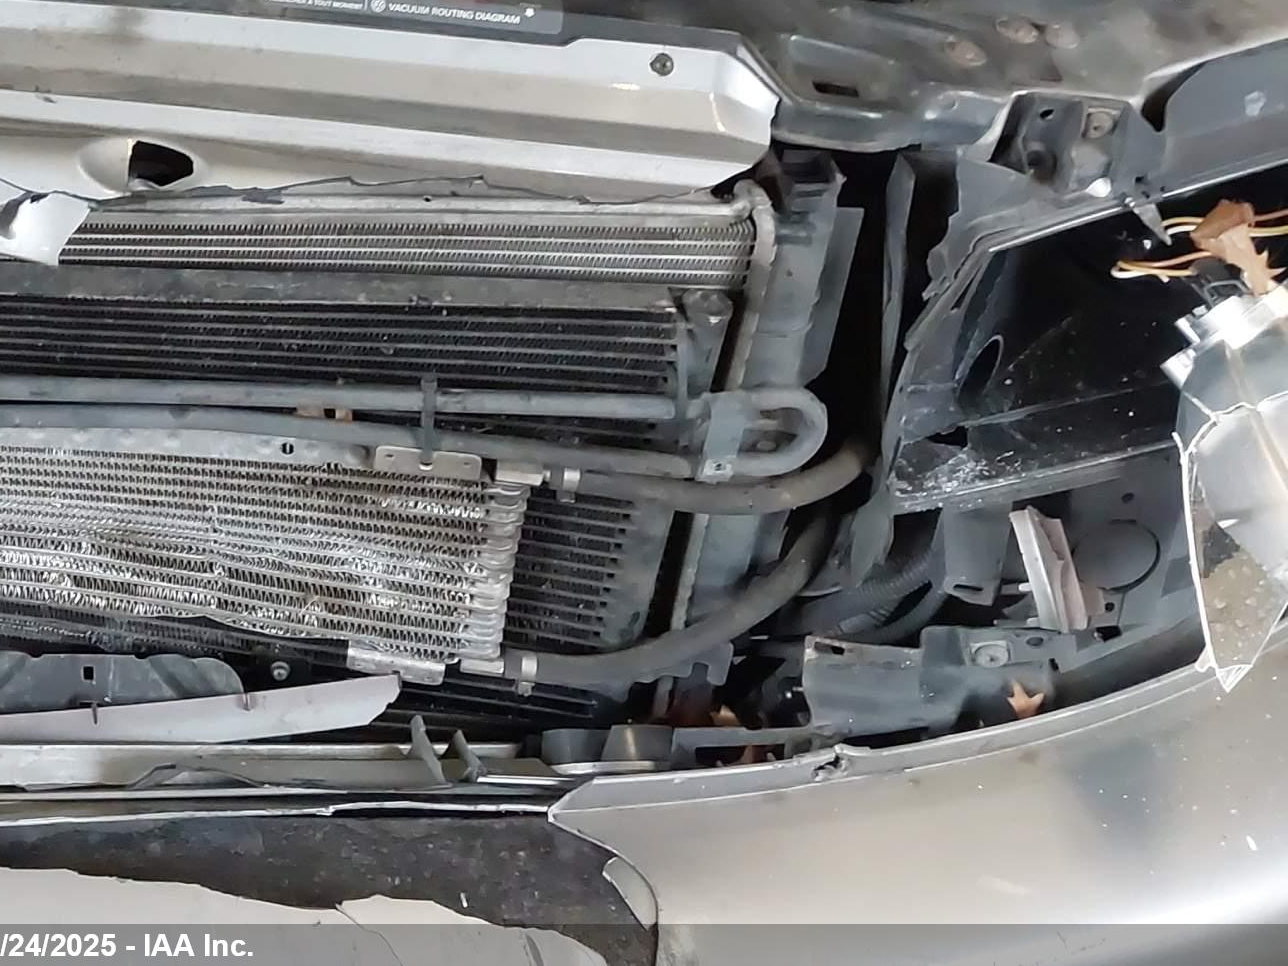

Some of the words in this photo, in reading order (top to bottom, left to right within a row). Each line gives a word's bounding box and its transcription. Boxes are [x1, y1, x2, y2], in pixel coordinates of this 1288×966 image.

[388, 2, 430, 15] VACUUM
[431, 6, 475, 20] ROUTING
[475, 12, 521, 25] DIAGRAM
